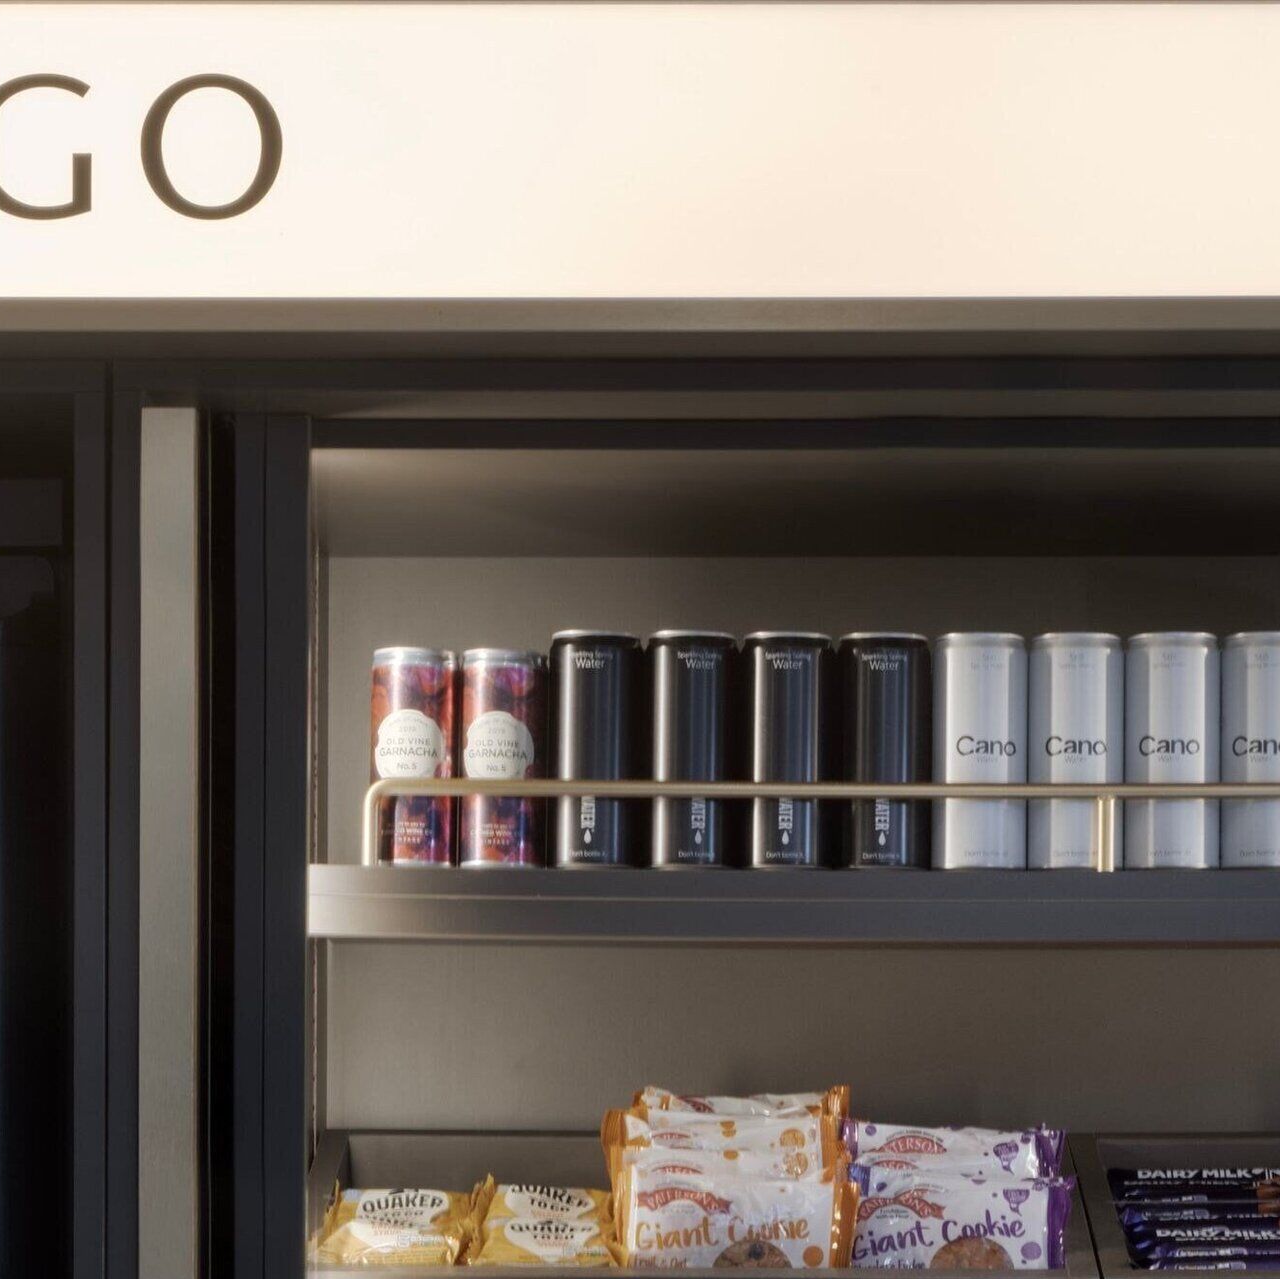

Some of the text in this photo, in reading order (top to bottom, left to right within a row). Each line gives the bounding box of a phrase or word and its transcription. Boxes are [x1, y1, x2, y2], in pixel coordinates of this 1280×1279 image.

[576, 658, 606, 669] Water
[686, 658, 716, 670] Water
[772, 659, 802, 670] Water
[870, 660, 898, 671] Water
[408, 737, 431, 746] VINE
[475, 739, 519, 748] OLD VINE
[955, 735, 1016, 756] Cano
[1045, 735, 1108, 756] Cano
[1139, 735, 1200, 756] Cano
[380, 747, 438, 759] GARNACHA
[468, 749, 527, 759] GARNACHA
[1138, 1168, 1252, 1179] DAIRY MILK
[362, 1194, 443, 1213] QUAKER
[636, 1216, 719, 1250] Giant
[851, 1209, 1025, 1261] Giant Cookie
